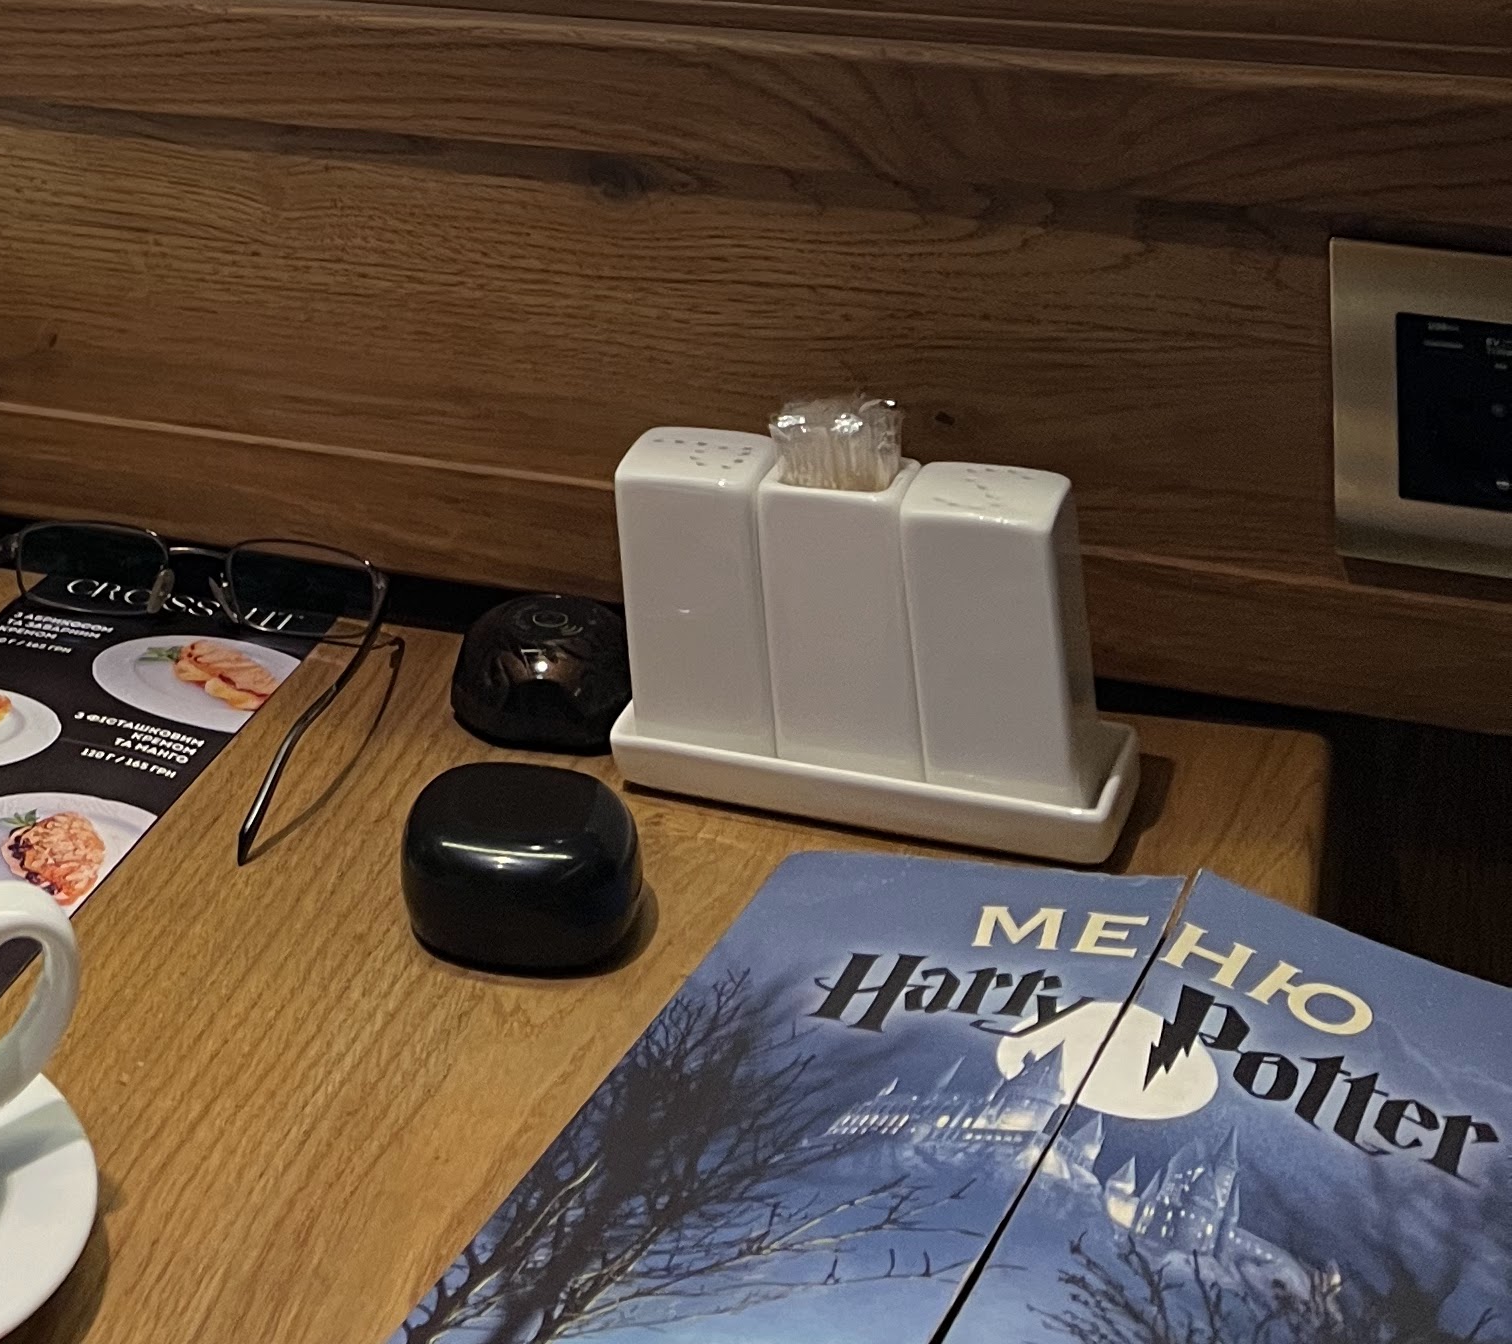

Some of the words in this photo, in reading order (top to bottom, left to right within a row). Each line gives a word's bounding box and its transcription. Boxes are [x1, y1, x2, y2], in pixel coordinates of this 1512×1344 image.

[7, 618, 23, 626] ТА
[25, 621, 101, 639] ЗАВАРНИМ
[23, 614, 114, 633] АБРИКОСОМ
[87, 714, 205, 747] ФІСТАШКОВИМ
[131, 732, 197, 756] КРЕМОМ
[114, 737, 132, 748] ТА
[134, 742, 188, 764] МАНГО
[125, 758, 149, 770] 165
[149, 764, 177, 779] ГРН
[972, 904, 1372, 1038] МЕНЮ
[812, 952, 1093, 1039] Harry
[1143, 986, 1501, 1180] Potter
